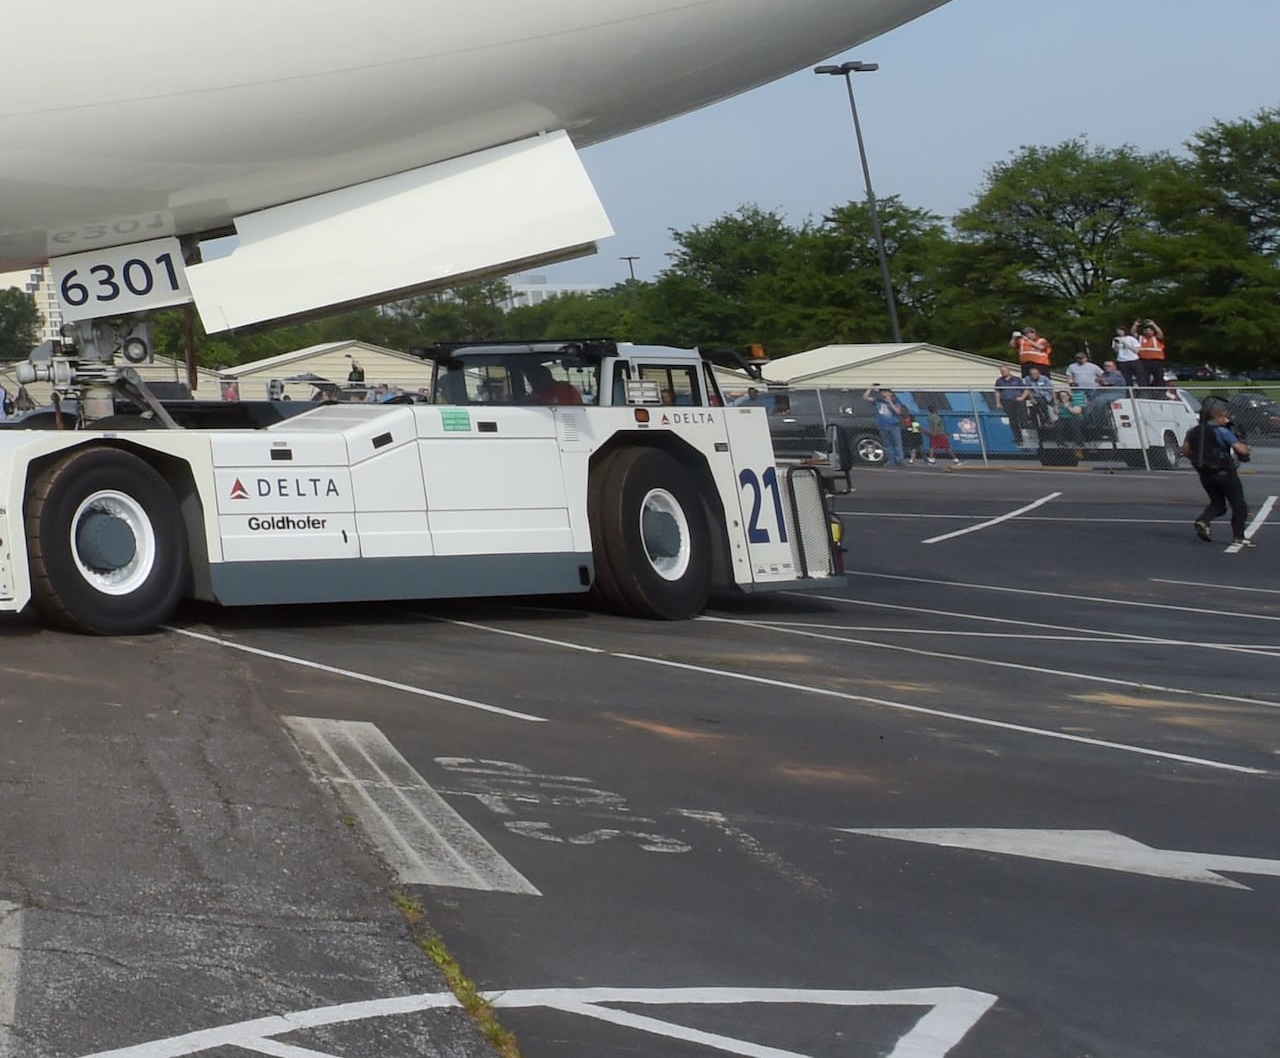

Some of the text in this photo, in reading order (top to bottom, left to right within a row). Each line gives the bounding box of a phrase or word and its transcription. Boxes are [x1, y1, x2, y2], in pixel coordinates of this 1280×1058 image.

[61, 253, 180, 306] 6301
[673, 413, 715, 424] DELTA
[257, 478, 339, 497] DELTA
[739, 466, 788, 544] 21
[248, 516, 327, 530] Goldhofer
